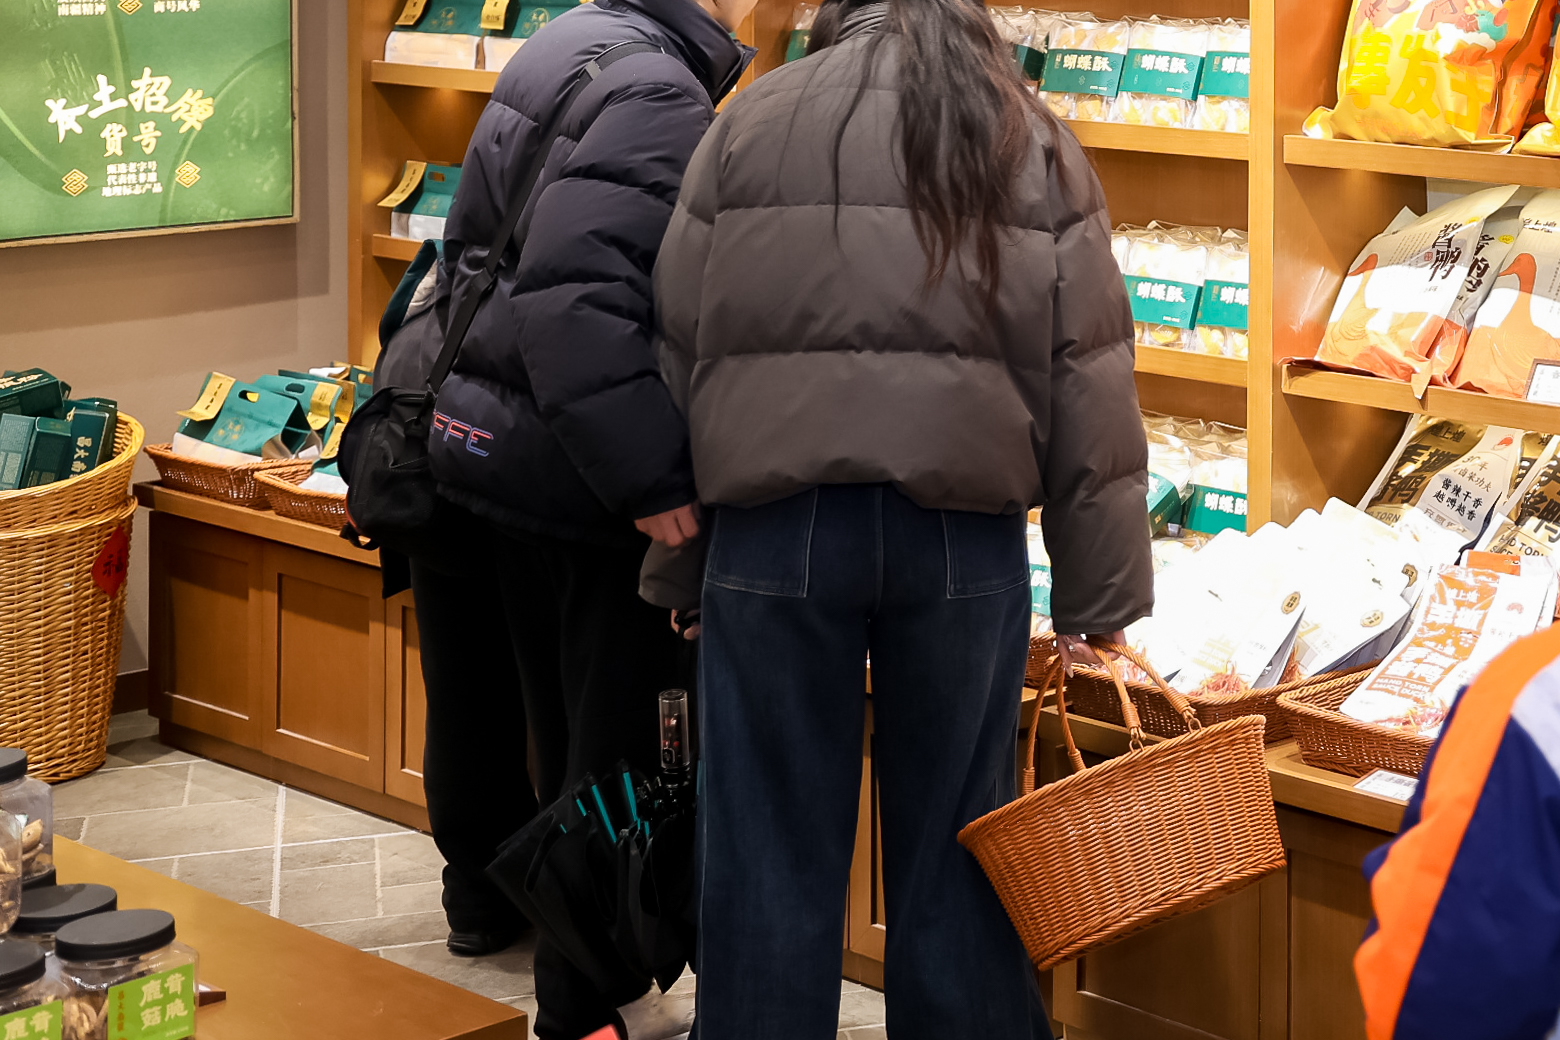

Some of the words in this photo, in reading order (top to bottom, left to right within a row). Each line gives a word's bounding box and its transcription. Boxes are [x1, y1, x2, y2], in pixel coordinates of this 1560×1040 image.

[1062, 54, 1112, 72] 蝴蝶酥
[1141, 54, 1188, 74] 蝴蝶酥
[99, 121, 162, 157] 货号
[1136, 281, 1186, 303] 蝴蝶酥
[1432, 490, 1477, 521] 越嚼越香
[1441, 477, 1483, 509] 酱辣干香
